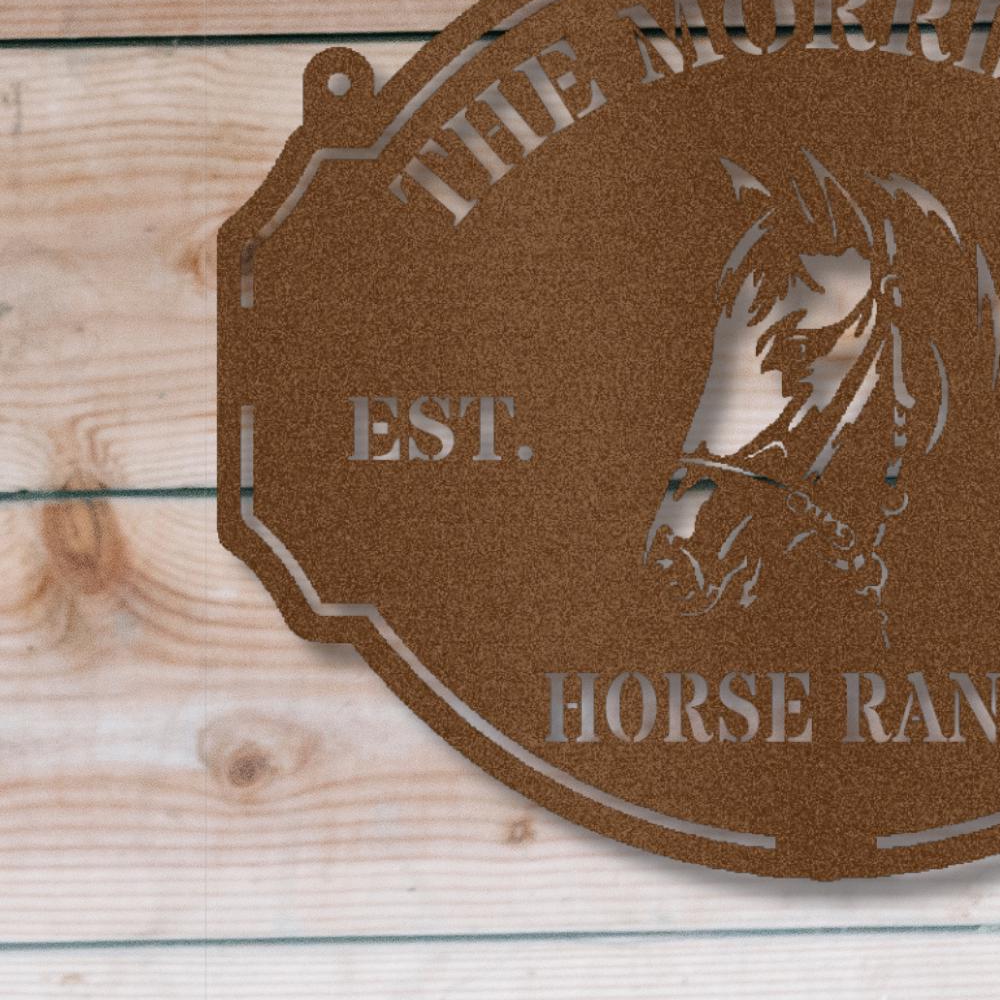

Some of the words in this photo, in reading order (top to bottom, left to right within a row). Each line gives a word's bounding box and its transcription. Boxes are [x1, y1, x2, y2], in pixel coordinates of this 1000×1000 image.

[387, 37, 608, 227] THE
[347, 396, 534, 461] EST.
[543, 671, 813, 743] HORSE
